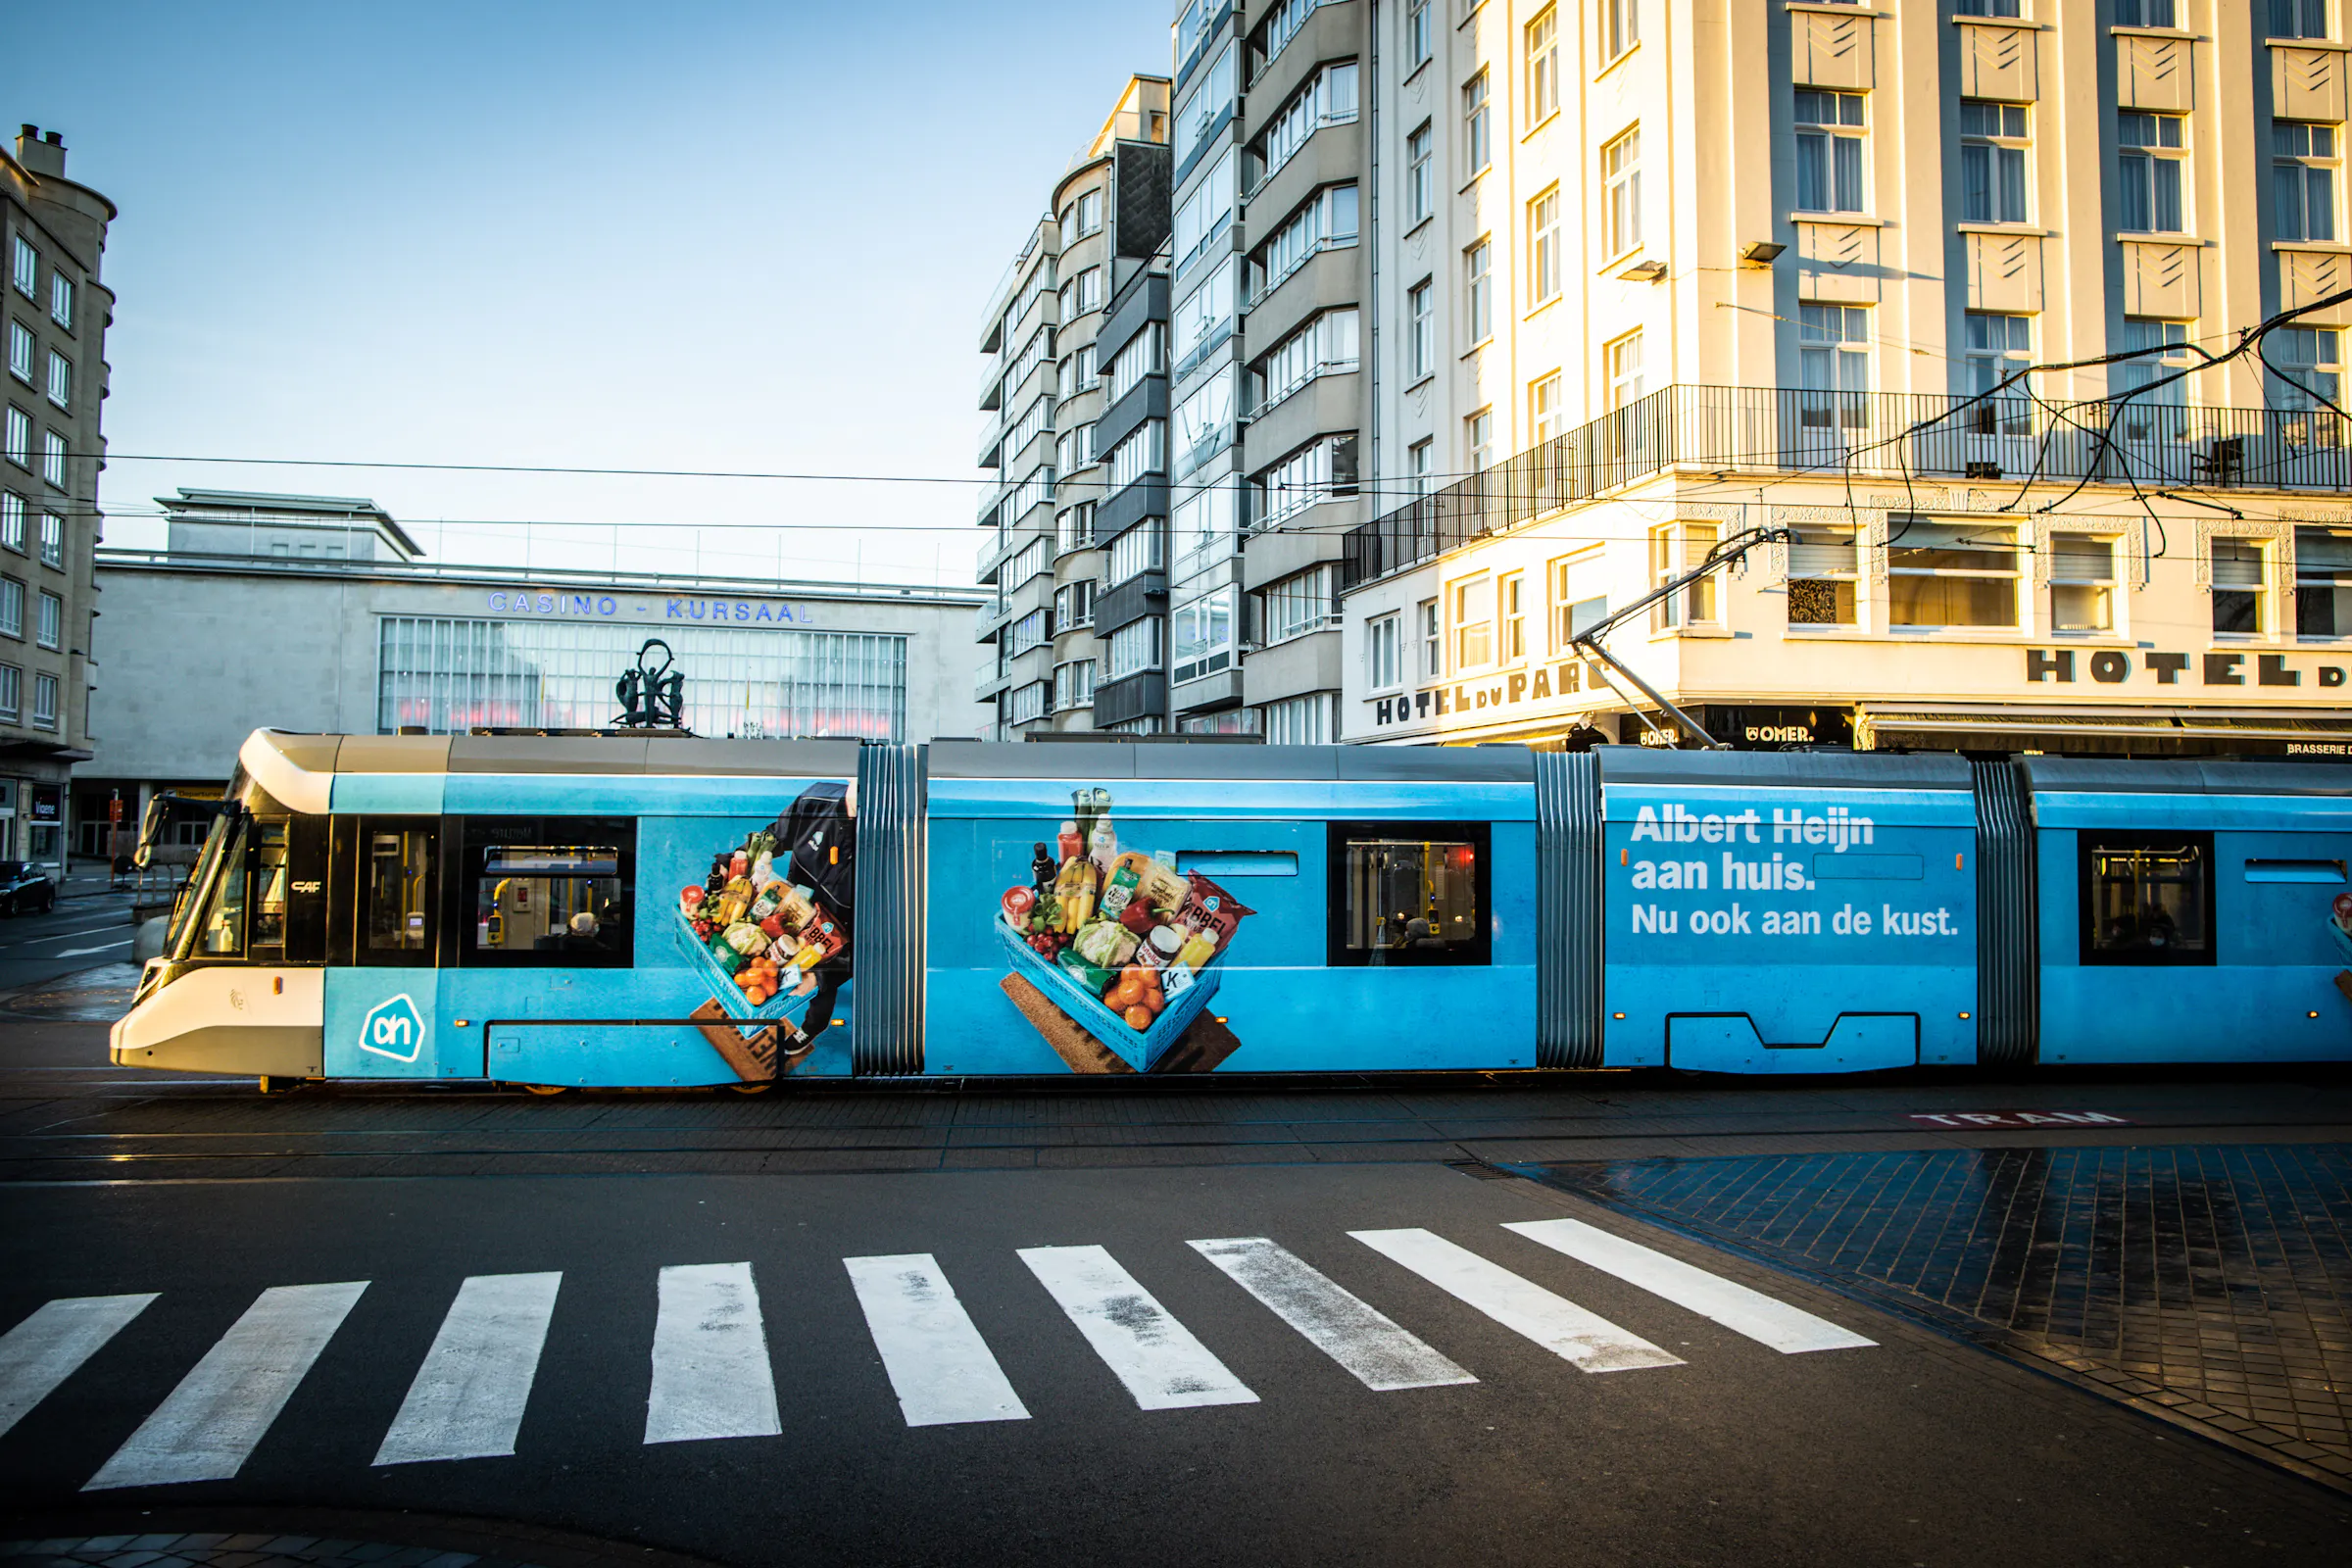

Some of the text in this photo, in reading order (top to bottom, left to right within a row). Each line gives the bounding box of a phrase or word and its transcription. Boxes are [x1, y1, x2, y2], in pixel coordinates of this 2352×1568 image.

[488, 592, 616, 615] CASINO
[666, 599, 813, 623] KURSAAL
[2027, 650, 2352, 687] HOTEL D
[1377, 686, 1471, 725] HOTEL
[1476, 687, 1502, 709] DU
[1760, 726, 1815, 742] OMER.
[2286, 744, 2346, 755] BRASSERIE
[1631, 805, 1874, 853] Albert Heijn
[291, 881, 321, 893] CAF
[1632, 853, 1815, 890] aan huis.
[1633, 903, 1958, 936] Nu ook aan de kust.
[1909, 1111, 2129, 1125] TRAM
